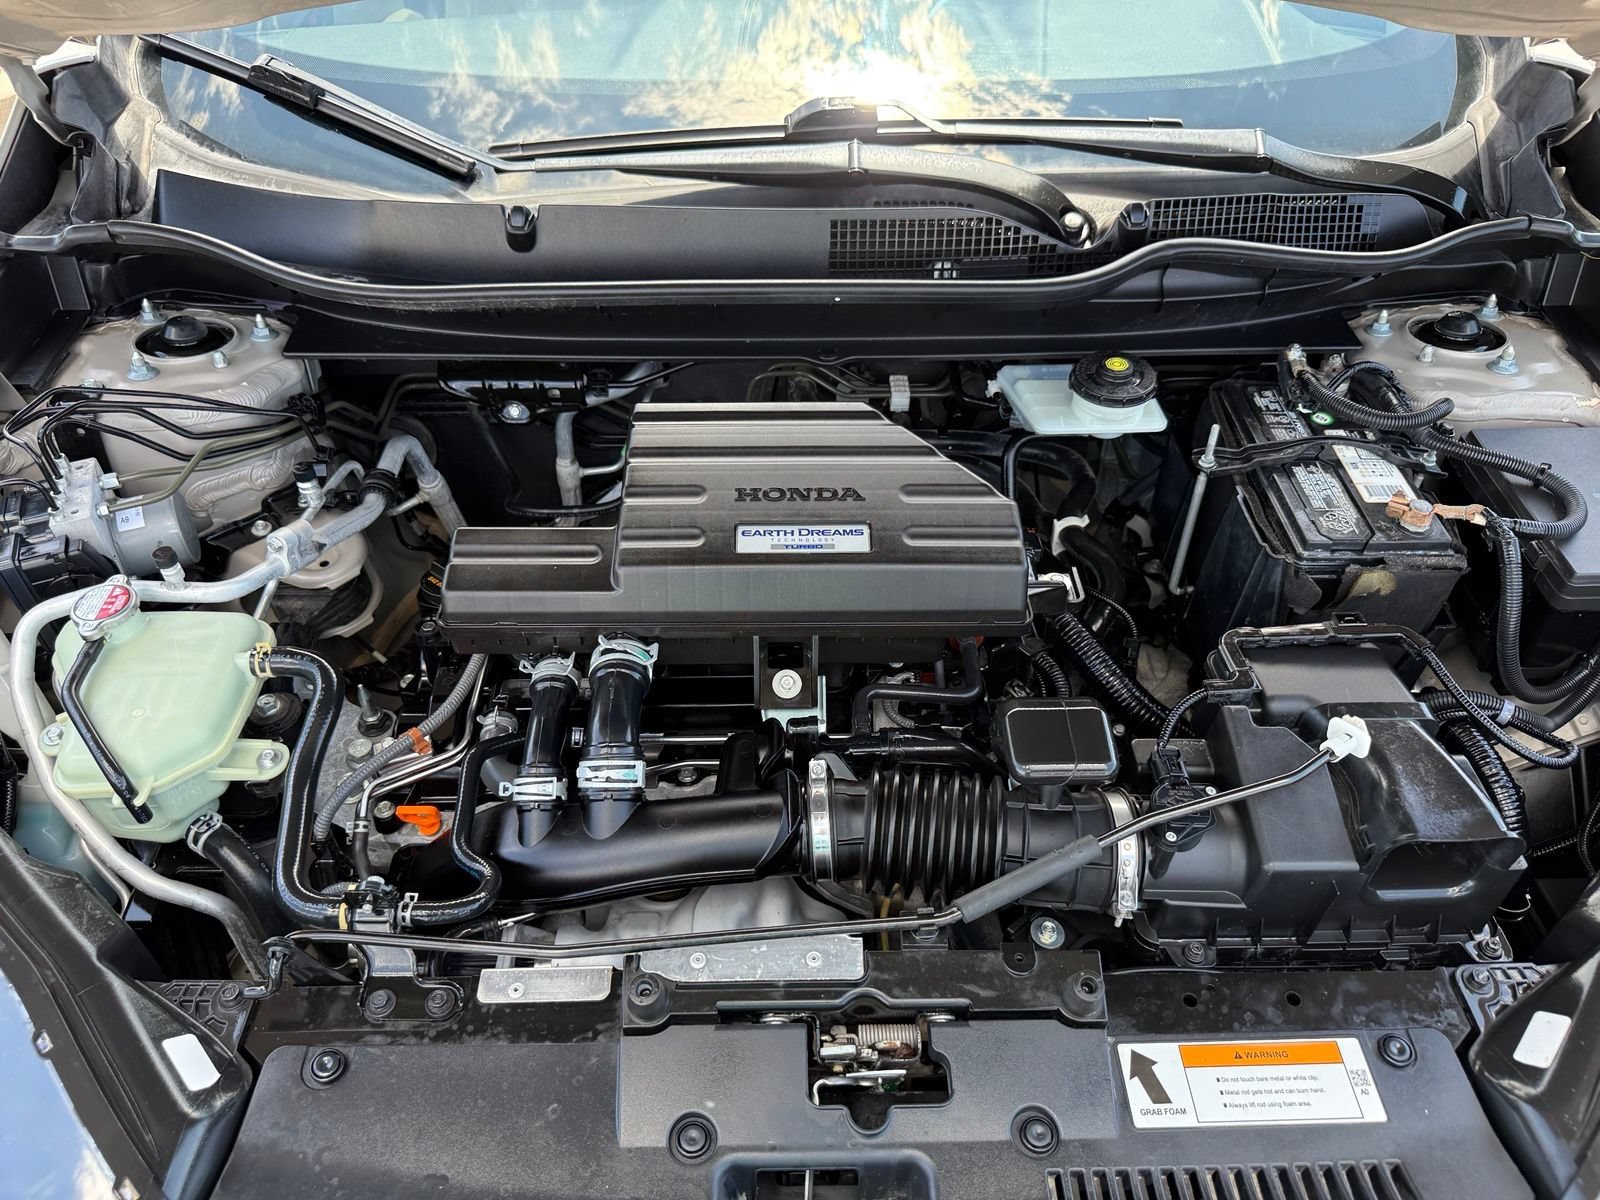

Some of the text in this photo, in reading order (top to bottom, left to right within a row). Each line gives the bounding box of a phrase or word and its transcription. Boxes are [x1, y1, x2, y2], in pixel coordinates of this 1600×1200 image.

[735, 487, 866, 502] HONDA
[120, 516, 130, 524] A9
[741, 528, 864, 537] EARTH DREAMS
[1244, 1050, 1289, 1060] WARNING
[1140, 1107, 1187, 1116] GRAB FOAM
